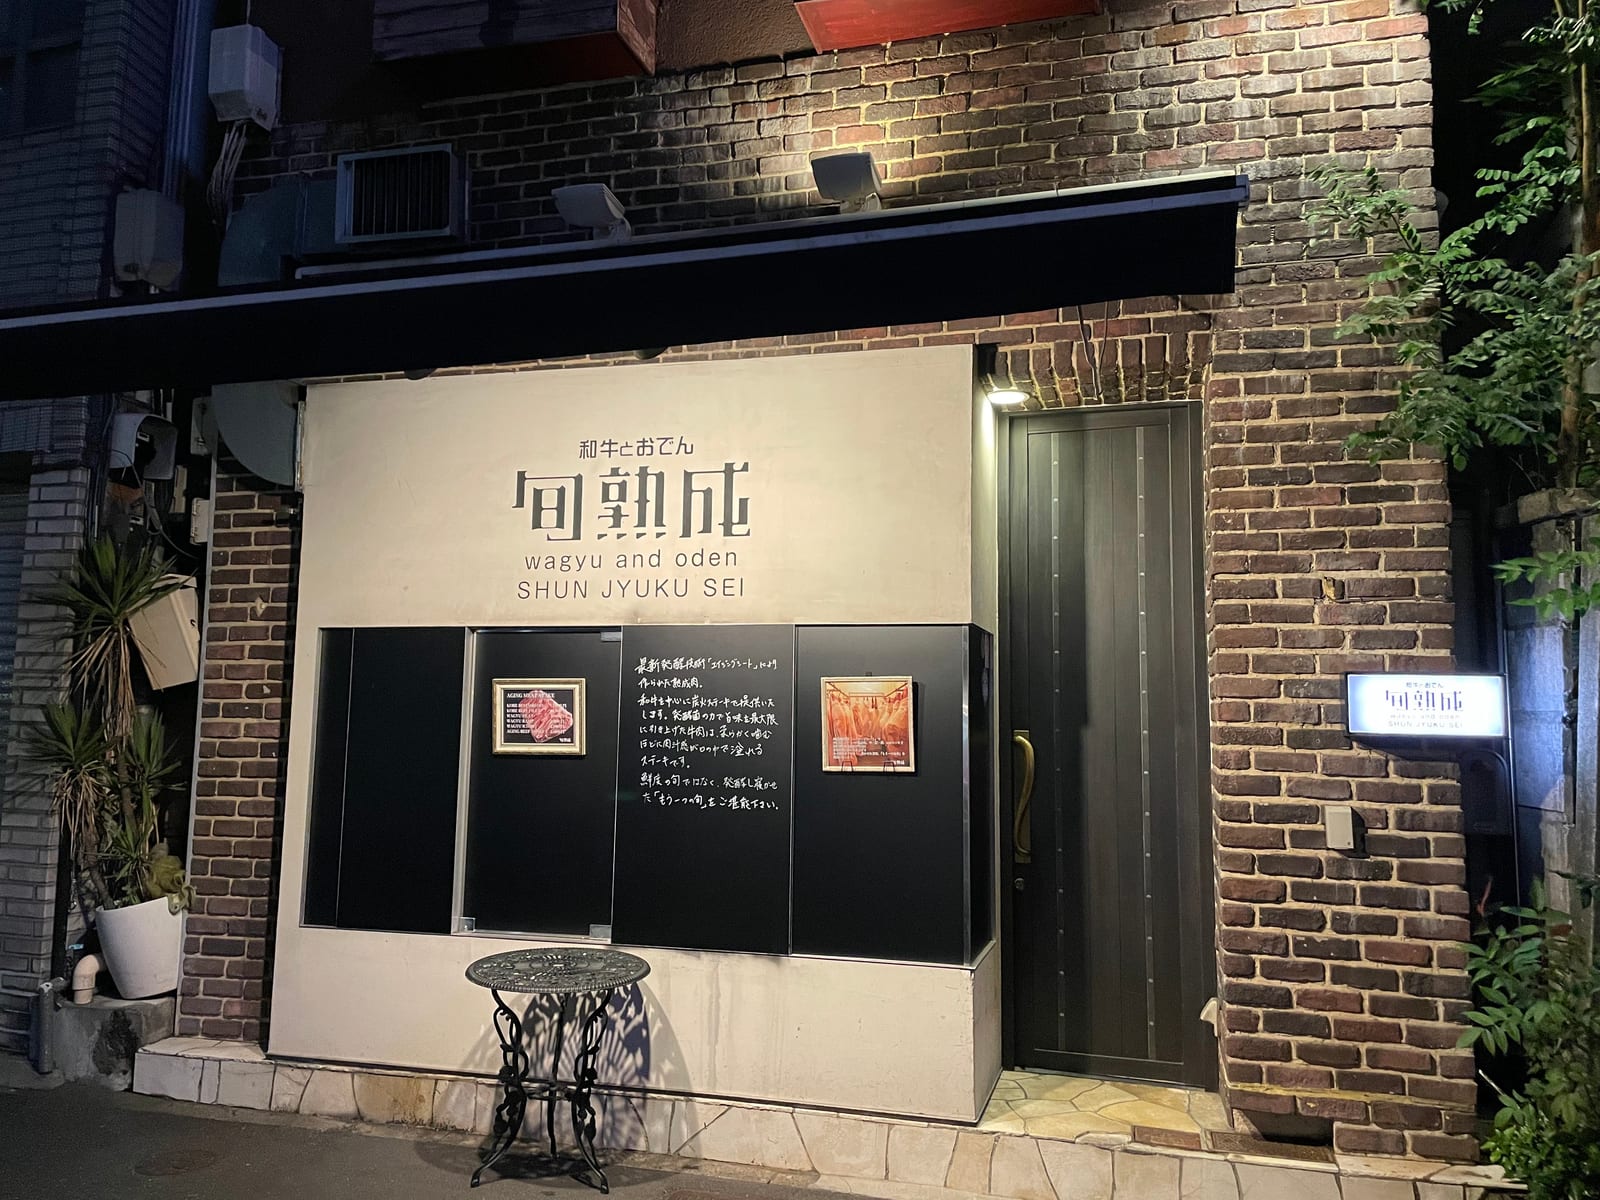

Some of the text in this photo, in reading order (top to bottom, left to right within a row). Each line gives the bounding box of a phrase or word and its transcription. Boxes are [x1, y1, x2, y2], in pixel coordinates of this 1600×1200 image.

[579, 436, 694, 459] 和牛とおでん
[512, 462, 751, 541] 旬熟成
[525, 548, 737, 572] wagyu and oden
[517, 577, 744, 599] SHUN JYUKU SEI
[640, 755, 690, 768] ステーキです。
